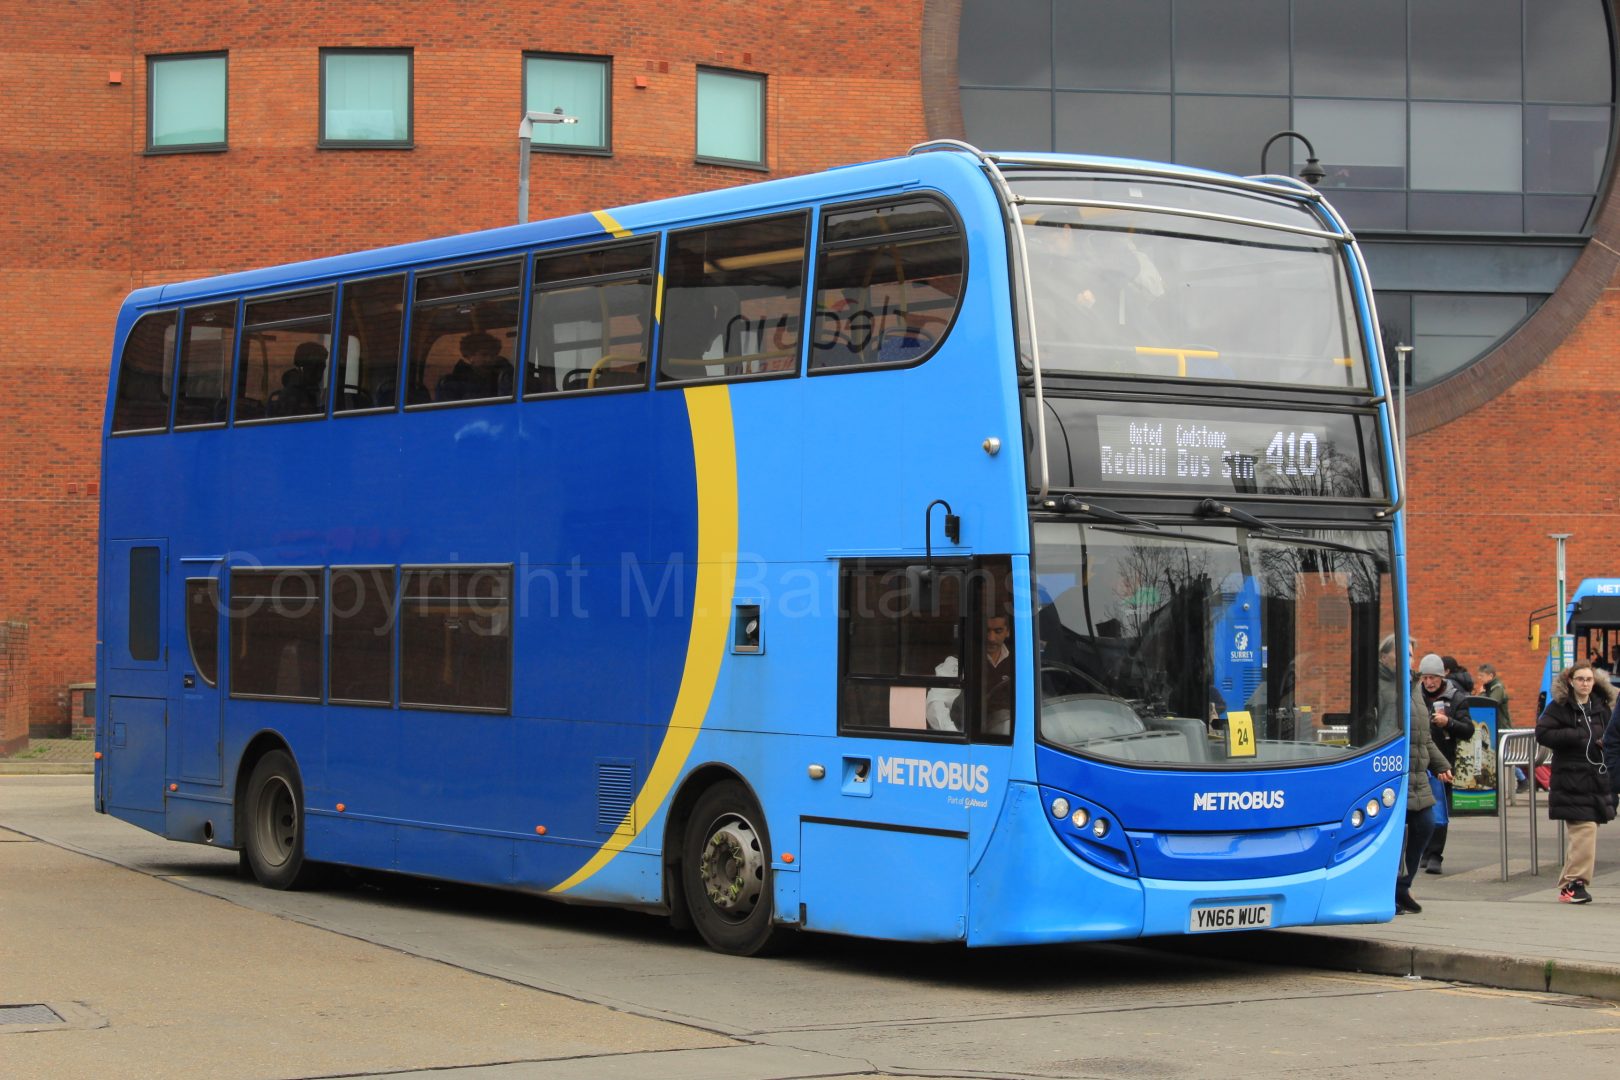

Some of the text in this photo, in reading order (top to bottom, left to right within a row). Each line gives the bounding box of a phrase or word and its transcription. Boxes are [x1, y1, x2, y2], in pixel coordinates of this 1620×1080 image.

[1176, 424, 1227, 449] Godstone
[1101, 446, 1254, 480] Redhill Bus Stn
[1265, 431, 1317, 476] 410
[1237, 728, 1249, 746] 24
[877, 756, 989, 793] METROBUS
[1373, 755, 1403, 773] 6988
[1193, 790, 1285, 812] METROBUS
[1197, 906, 1267, 928] YN66 WUC
